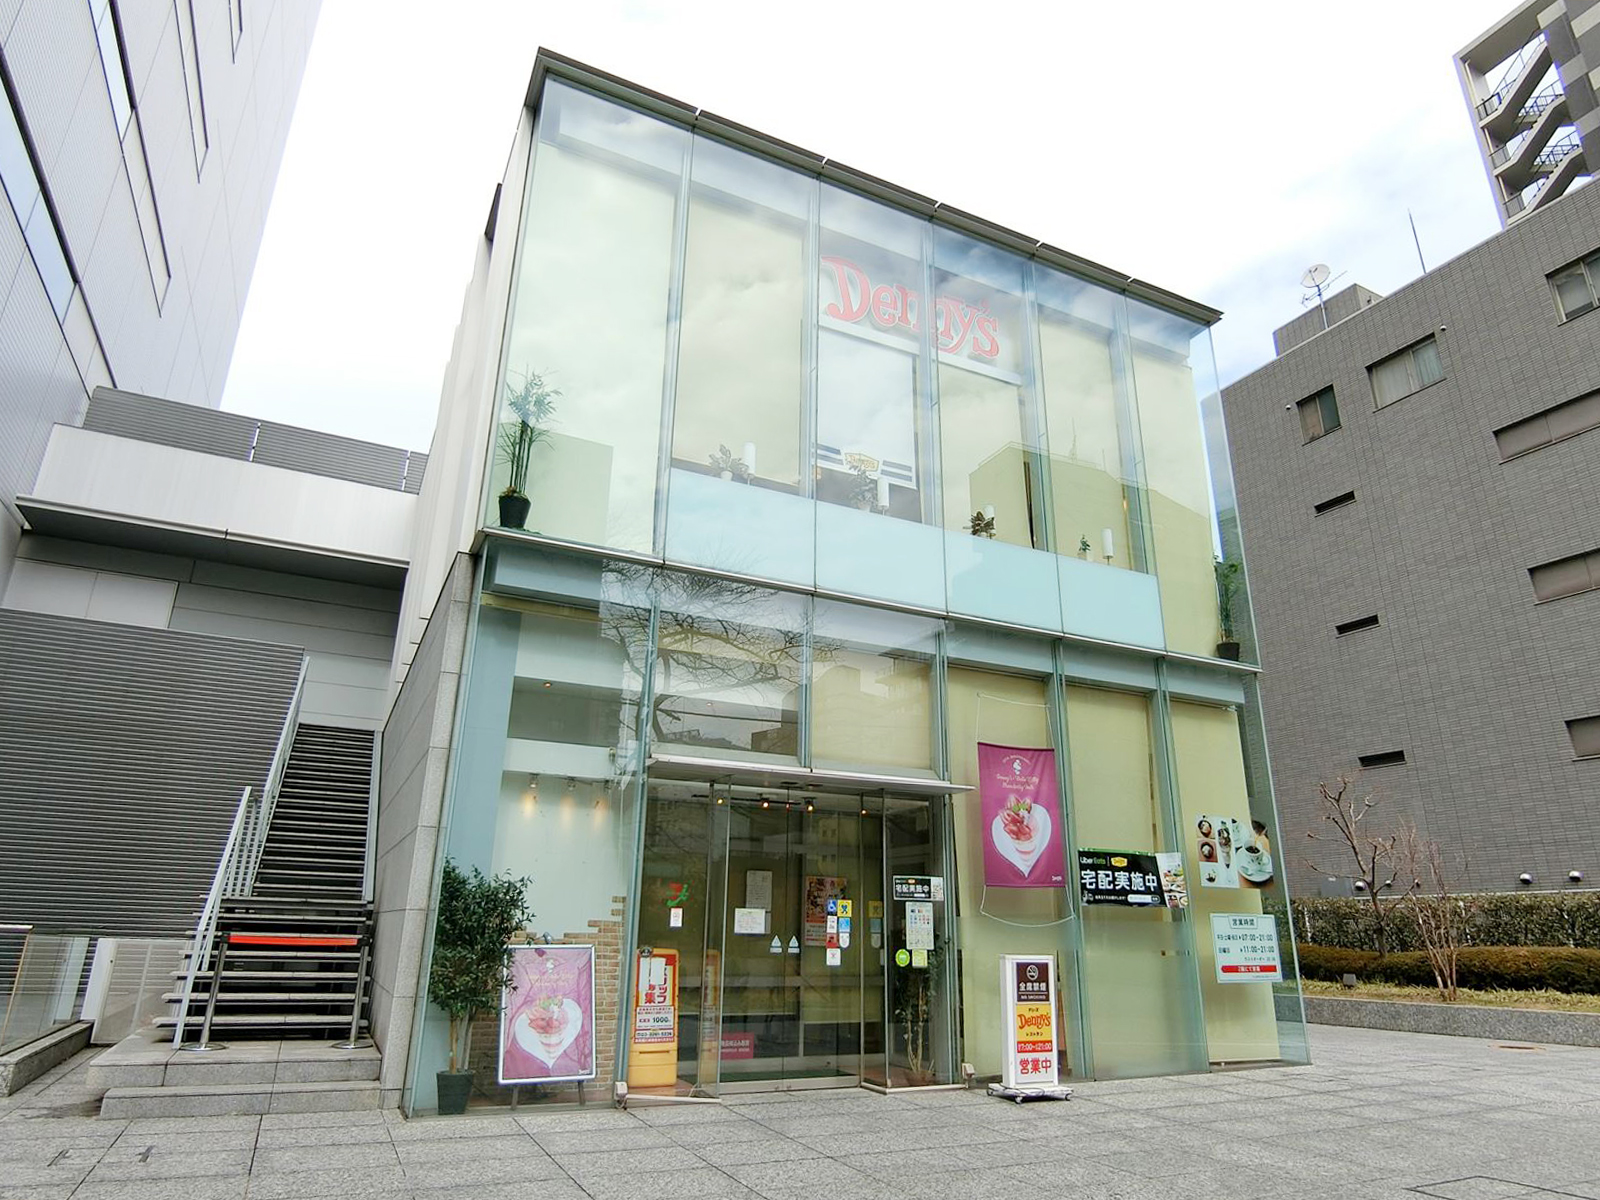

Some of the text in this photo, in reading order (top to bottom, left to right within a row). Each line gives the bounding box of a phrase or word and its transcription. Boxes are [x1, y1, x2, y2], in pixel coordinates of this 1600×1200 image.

[820, 255, 1000, 359] Denny's
[1080, 856, 1093, 864] Uber
[1081, 869, 1158, 892] 宅配実施中
[1232, 918, 1255, 926] 営業時間
[1019, 982, 1047, 991] 全席禁煙
[1017, 1012, 1051, 1030] Denny's
[1019, 1057, 1052, 1075] 営業中
